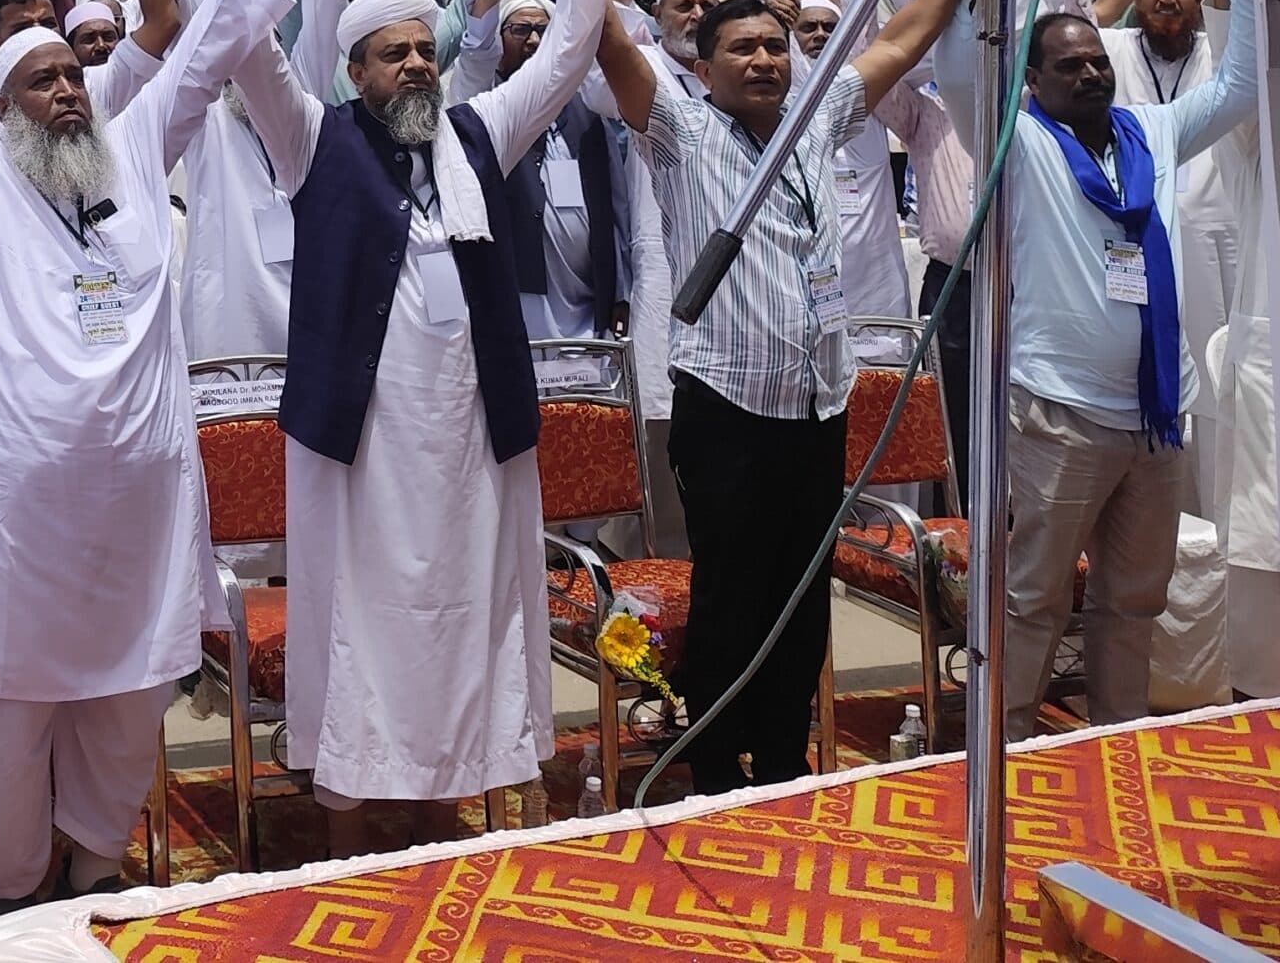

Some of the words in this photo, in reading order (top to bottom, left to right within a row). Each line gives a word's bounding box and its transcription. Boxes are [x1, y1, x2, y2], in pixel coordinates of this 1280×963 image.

[202, 388, 238, 396] MOULANA
[252, 384, 283, 392] MOHAMM
[200, 397, 238, 406] MAQSOOD
[240, 396, 263, 404] IMRAN
